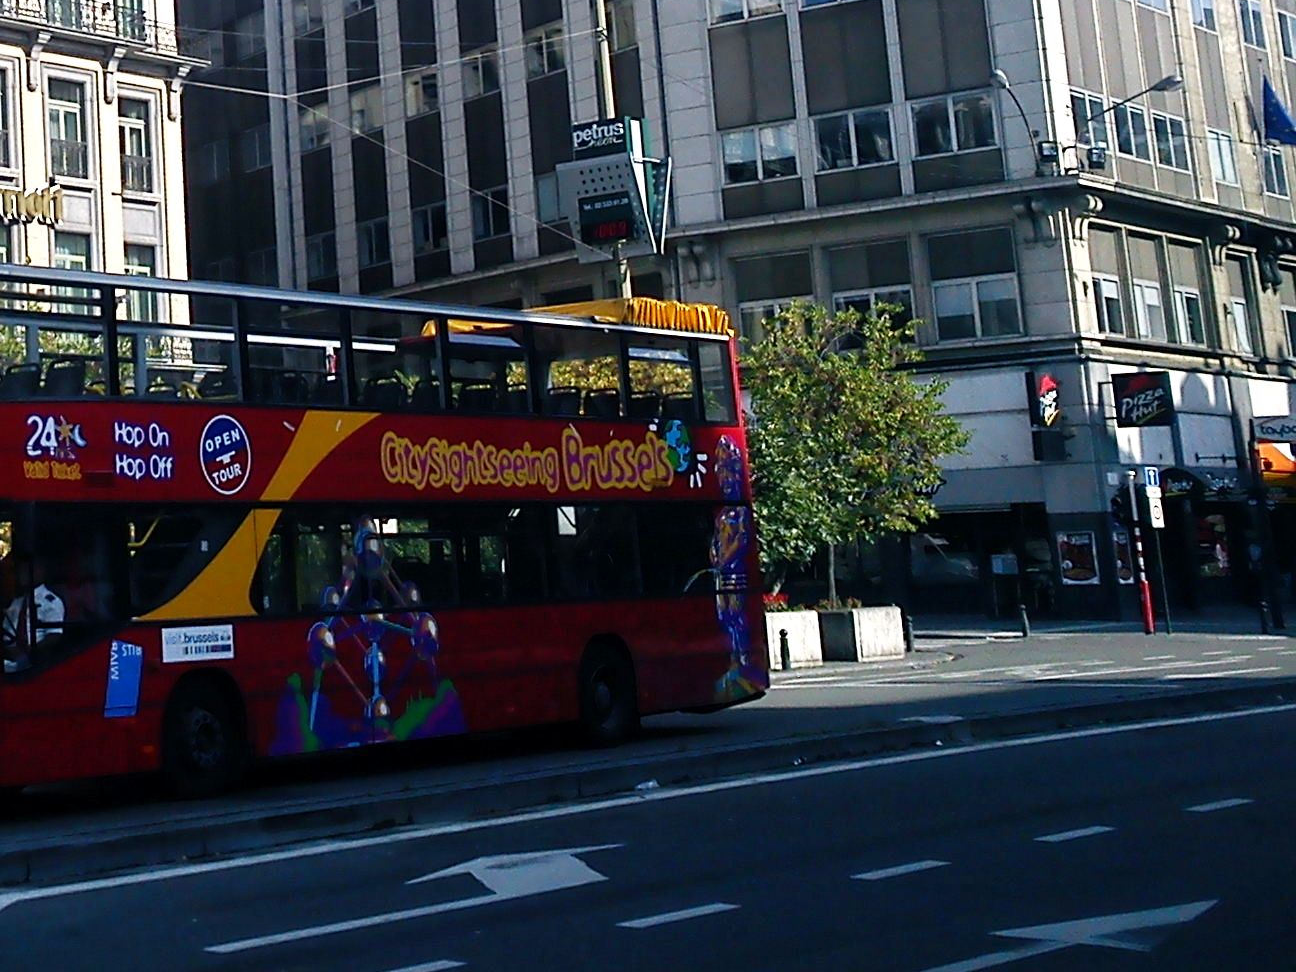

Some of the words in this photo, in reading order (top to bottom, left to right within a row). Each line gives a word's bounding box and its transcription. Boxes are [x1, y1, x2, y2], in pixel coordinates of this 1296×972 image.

[573, 123, 624, 147] petrus
[1121, 388, 1165, 418] Pizza
[1131, 402, 1160, 421] Hut
[26, 415, 57, 456] 24
[115, 421, 145, 447] Hop
[149, 422, 170, 447] On
[205, 428, 241, 452] OPEN
[115, 453, 146, 480] Hop
[150, 454, 173, 479] Off
[562, 427, 674, 491] Brussels
[212, 462, 243, 485] TOUR
[122, 644, 143, 657] STIB
